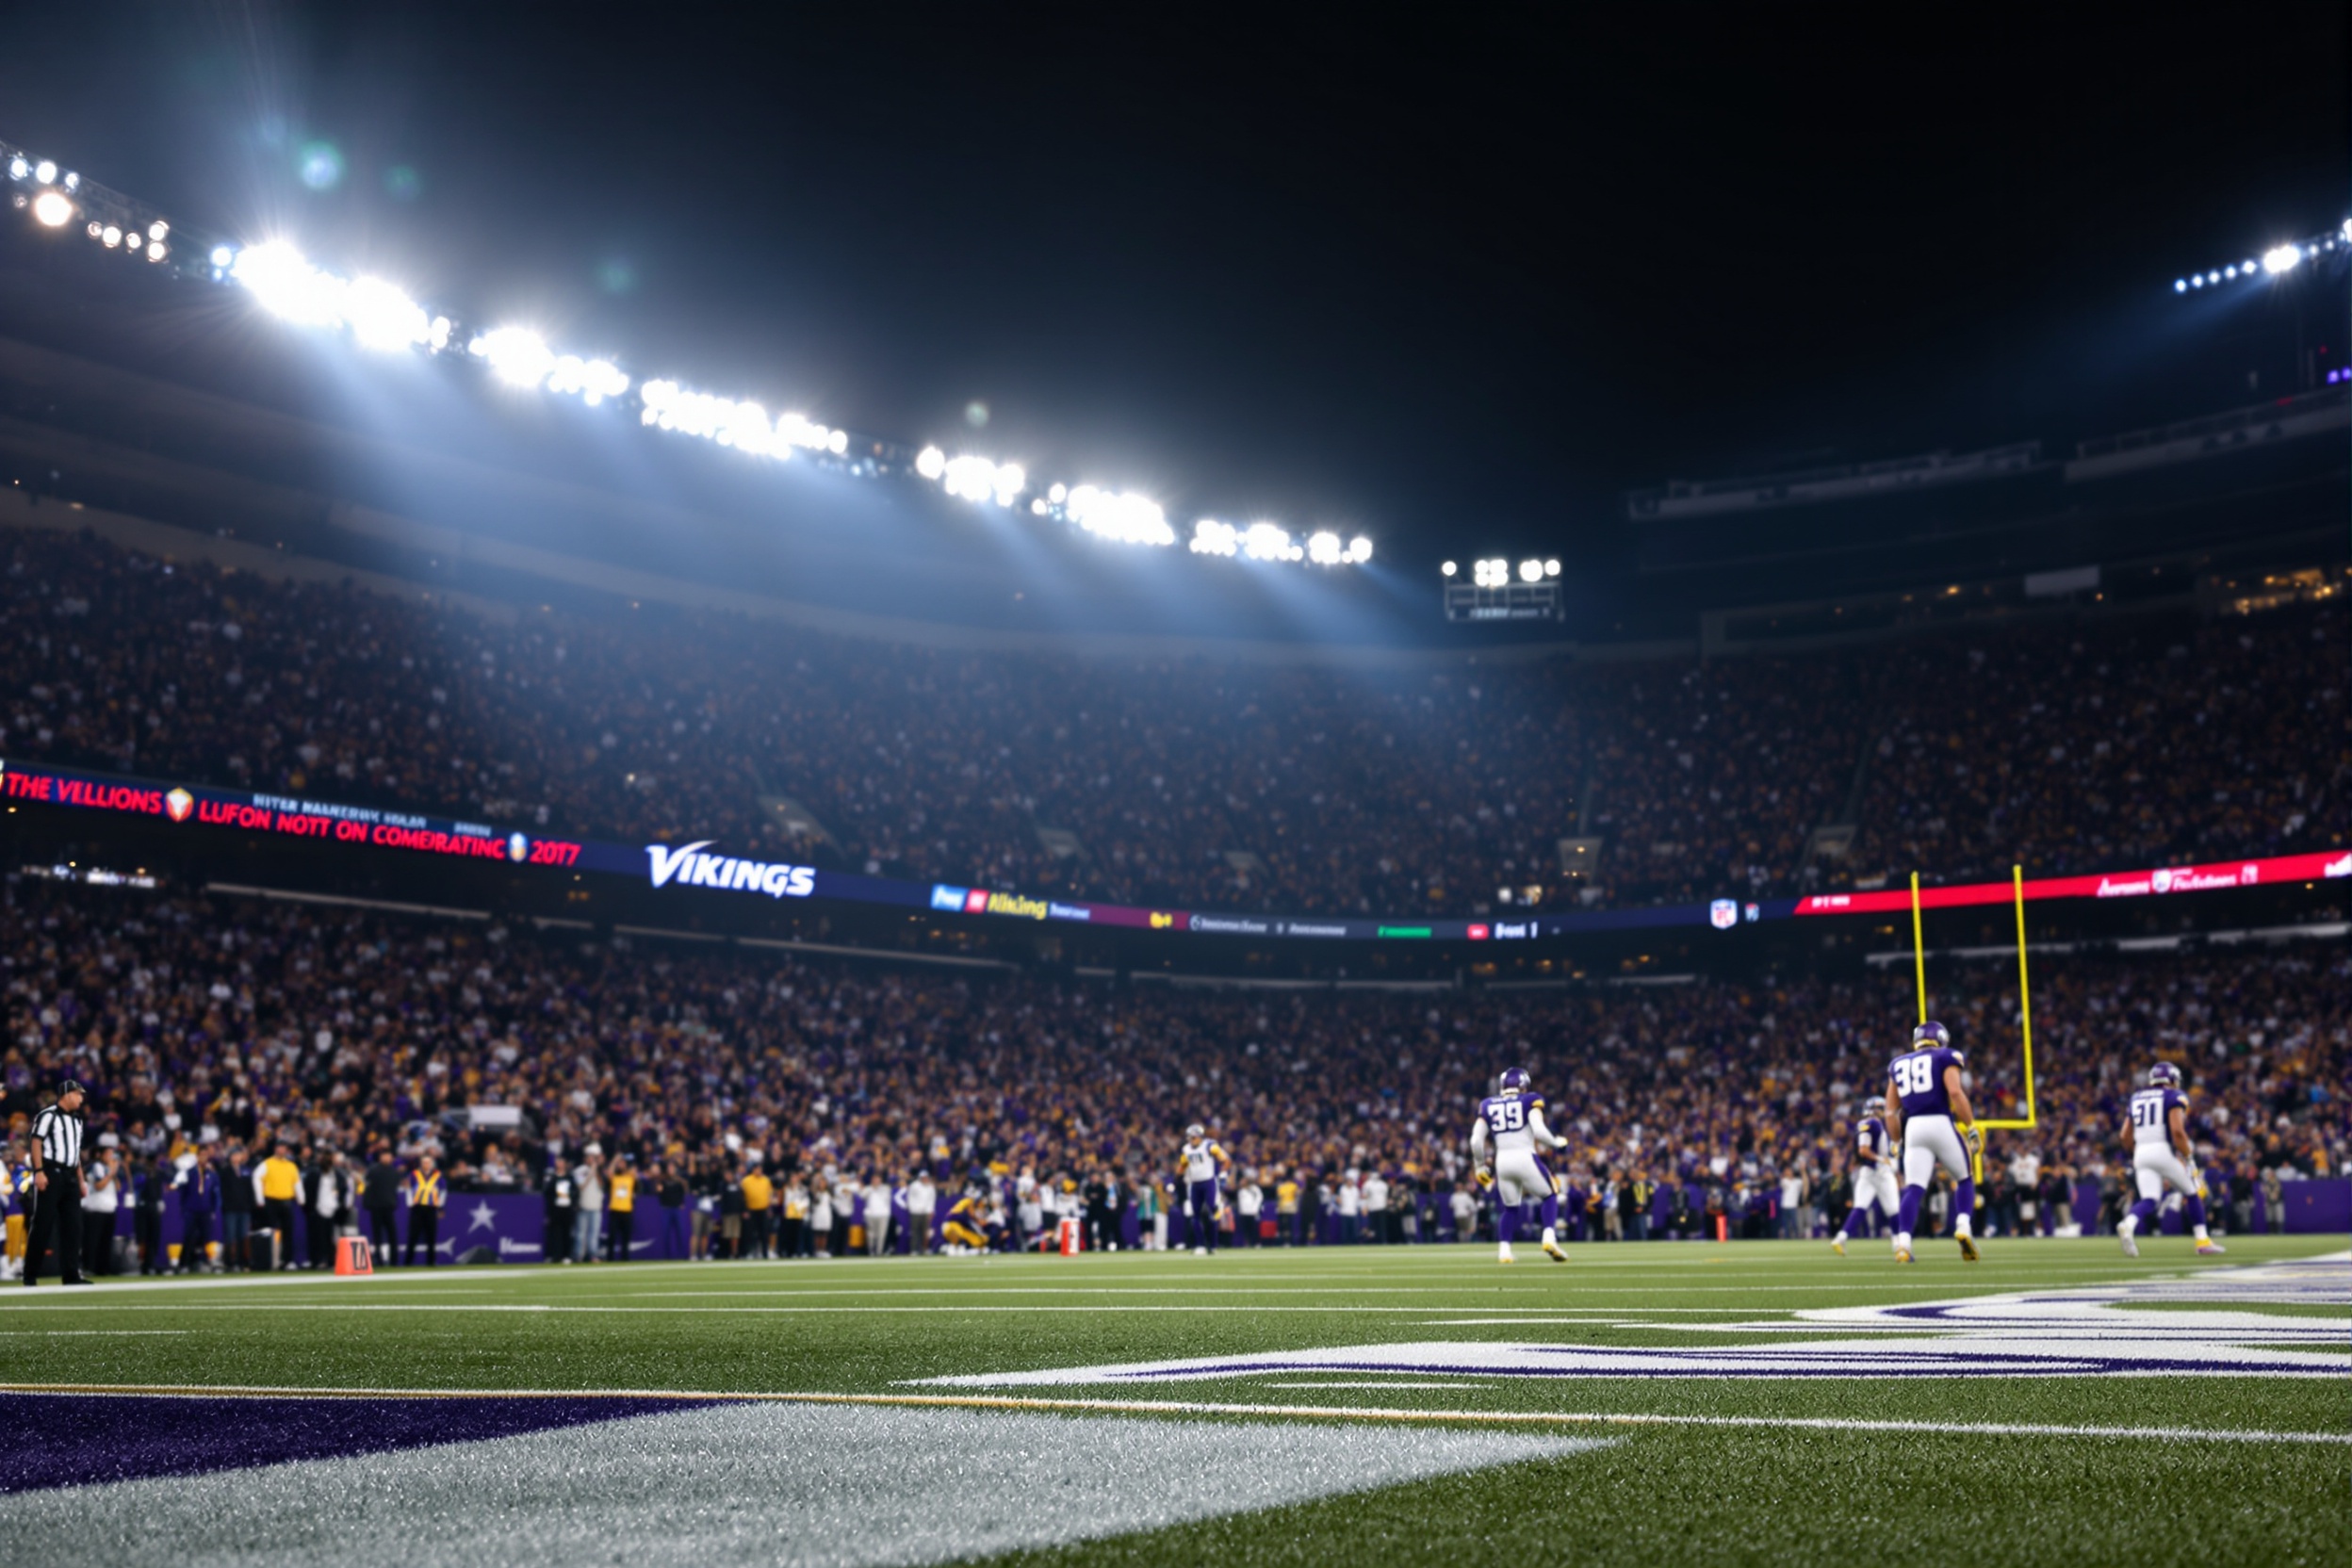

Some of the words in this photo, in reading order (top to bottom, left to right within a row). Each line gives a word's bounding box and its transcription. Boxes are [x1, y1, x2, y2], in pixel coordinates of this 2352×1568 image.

[7, 772, 53, 800] THE
[198, 800, 272, 830] LUFON
[276, 812, 332, 838] NOTT
[335, 819, 368, 842] ON
[530, 840, 581, 867] 2017
[1487, 1101, 1525, 1132] 39
